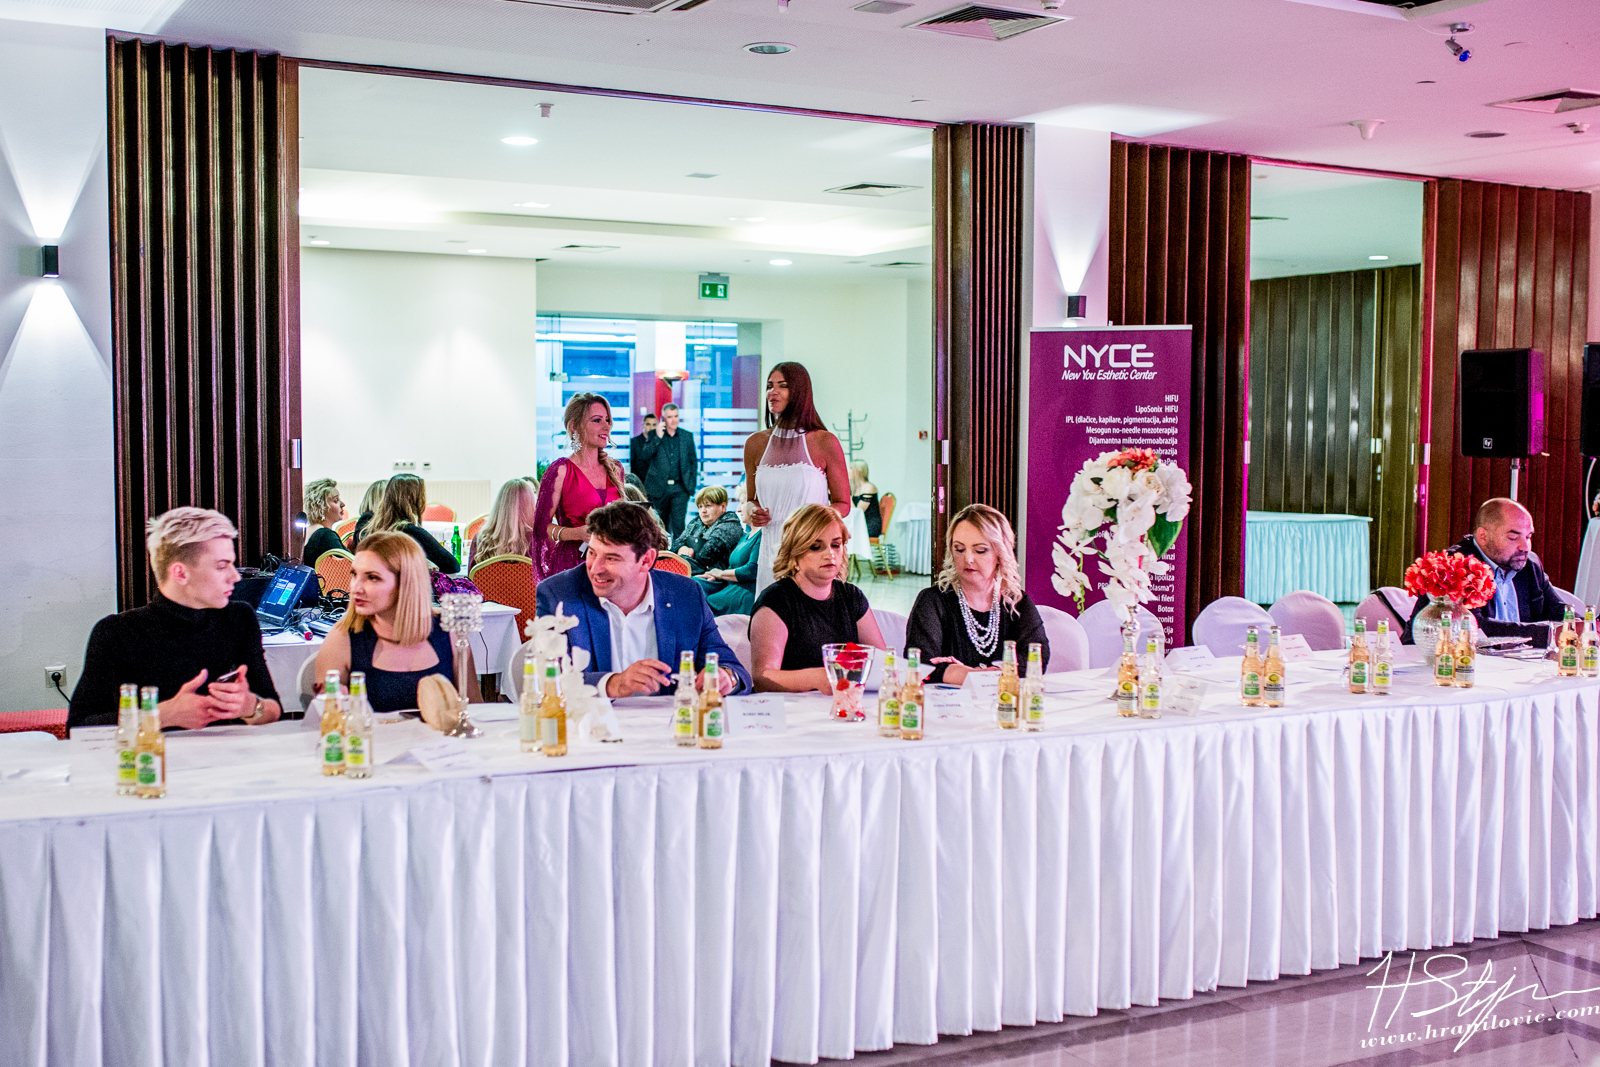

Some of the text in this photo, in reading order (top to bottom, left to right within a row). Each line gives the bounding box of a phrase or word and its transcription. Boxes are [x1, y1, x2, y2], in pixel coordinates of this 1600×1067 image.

[1064, 344, 1154, 368] NYCE
[1062, 368, 1157, 380] New You Esthetic Center
[1165, 394, 1179, 402] HIFU
[1135, 405, 1179, 414] LipoSonix HIFU
[1098, 415, 1123, 425] kapilare,
[1123, 415, 1161, 425] pigmentacija,
[1162, 415, 1178, 424] akne)
[1086, 426, 1178, 435] Mesogun no-needle mezoterapija
[1089, 436, 1178, 446] Dijamantna mikrodermoabrazija
[1161, 594, 1175, 602] fileri
[1157, 604, 1175, 613] Botox
